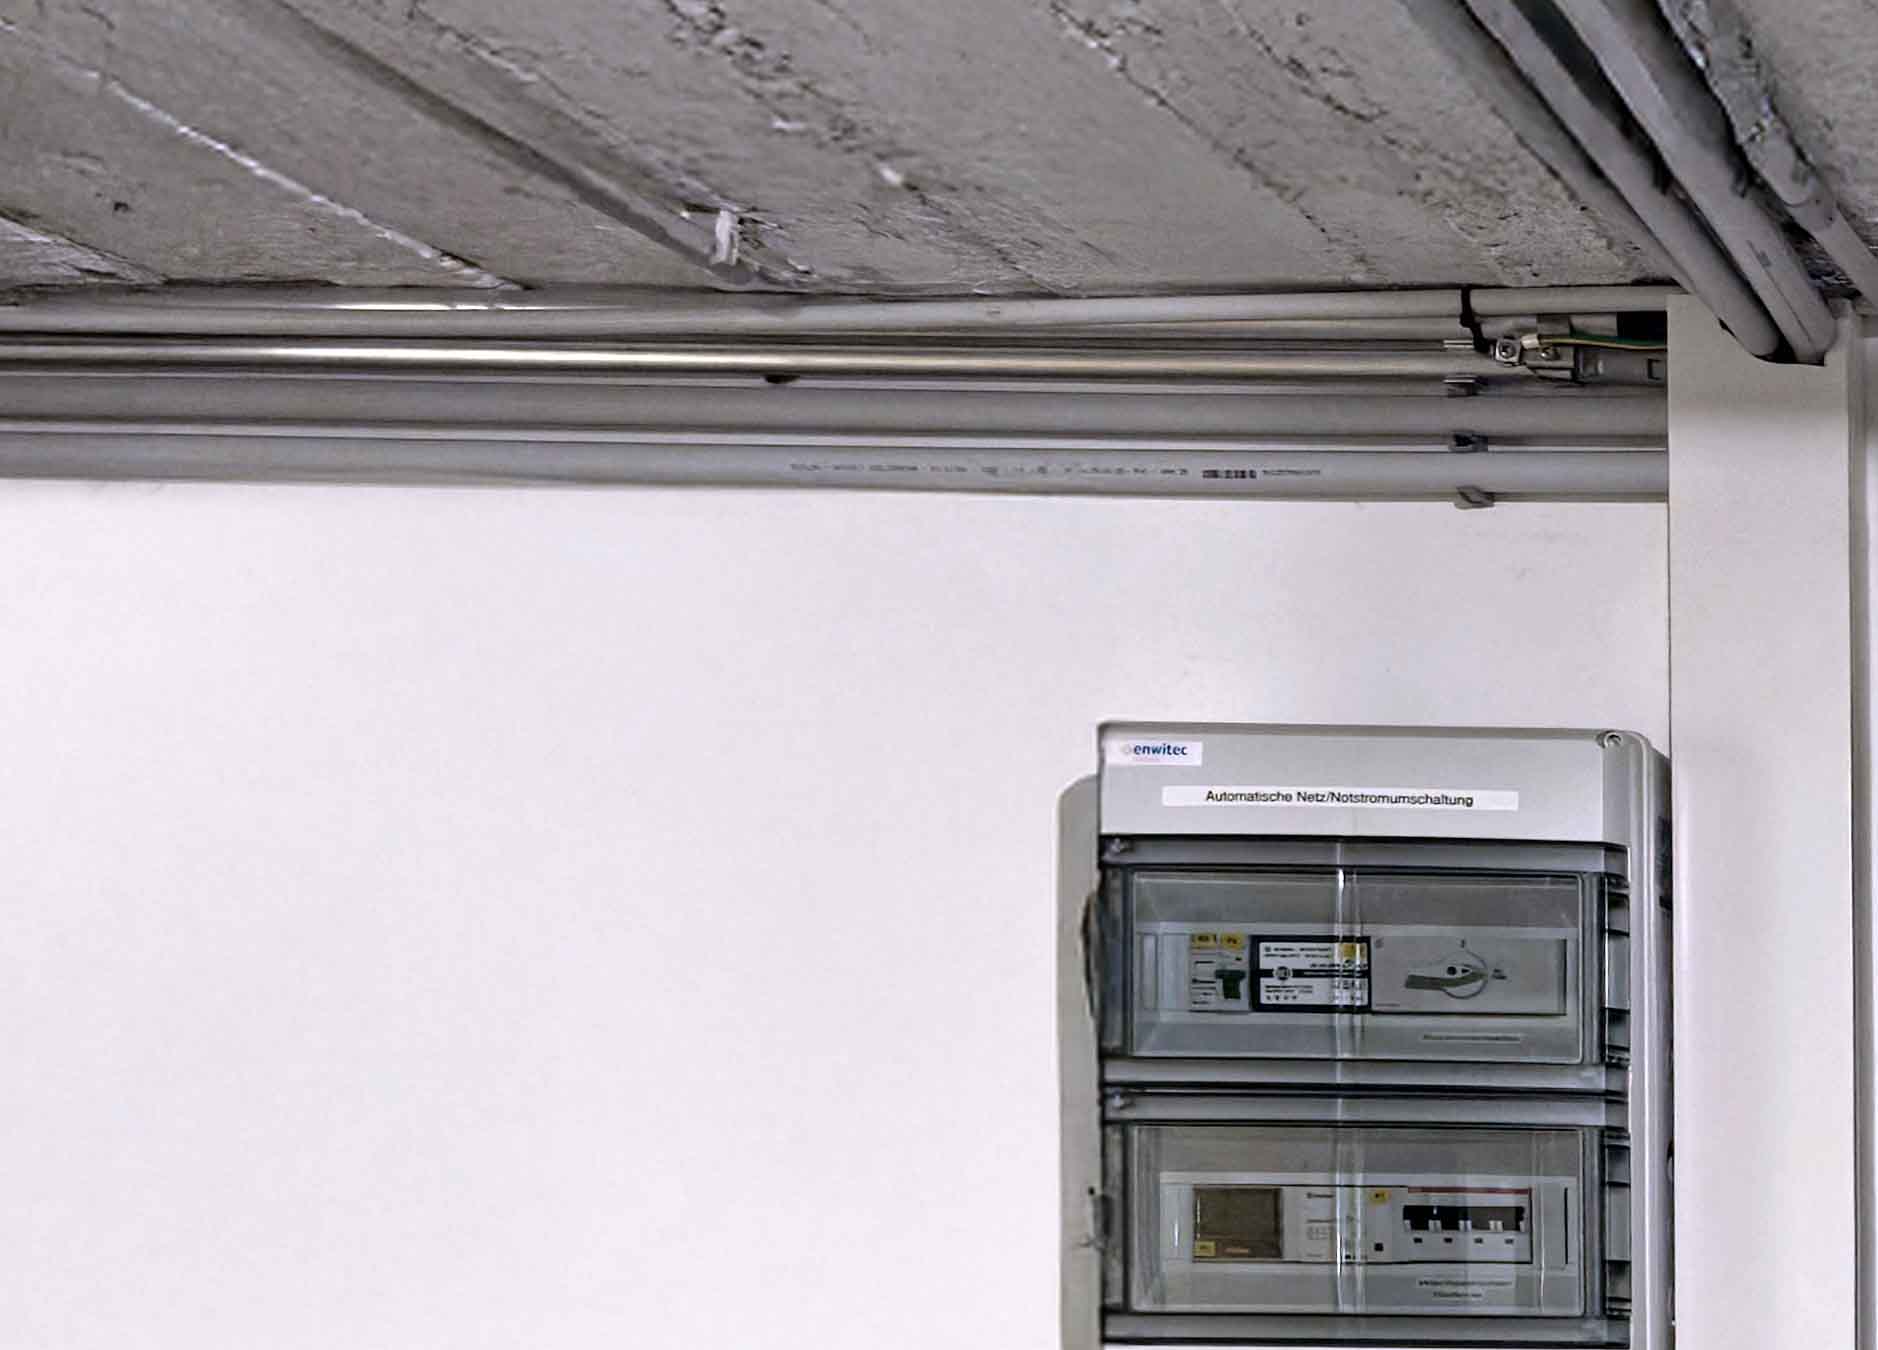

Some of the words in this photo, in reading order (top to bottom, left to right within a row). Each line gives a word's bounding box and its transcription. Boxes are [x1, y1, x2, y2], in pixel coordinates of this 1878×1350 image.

[1133, 743, 1188, 756] enwitec
[1205, 790, 1293, 803] Automatische
[1297, 791, 1474, 808] Netz/Notstromumschaltung
